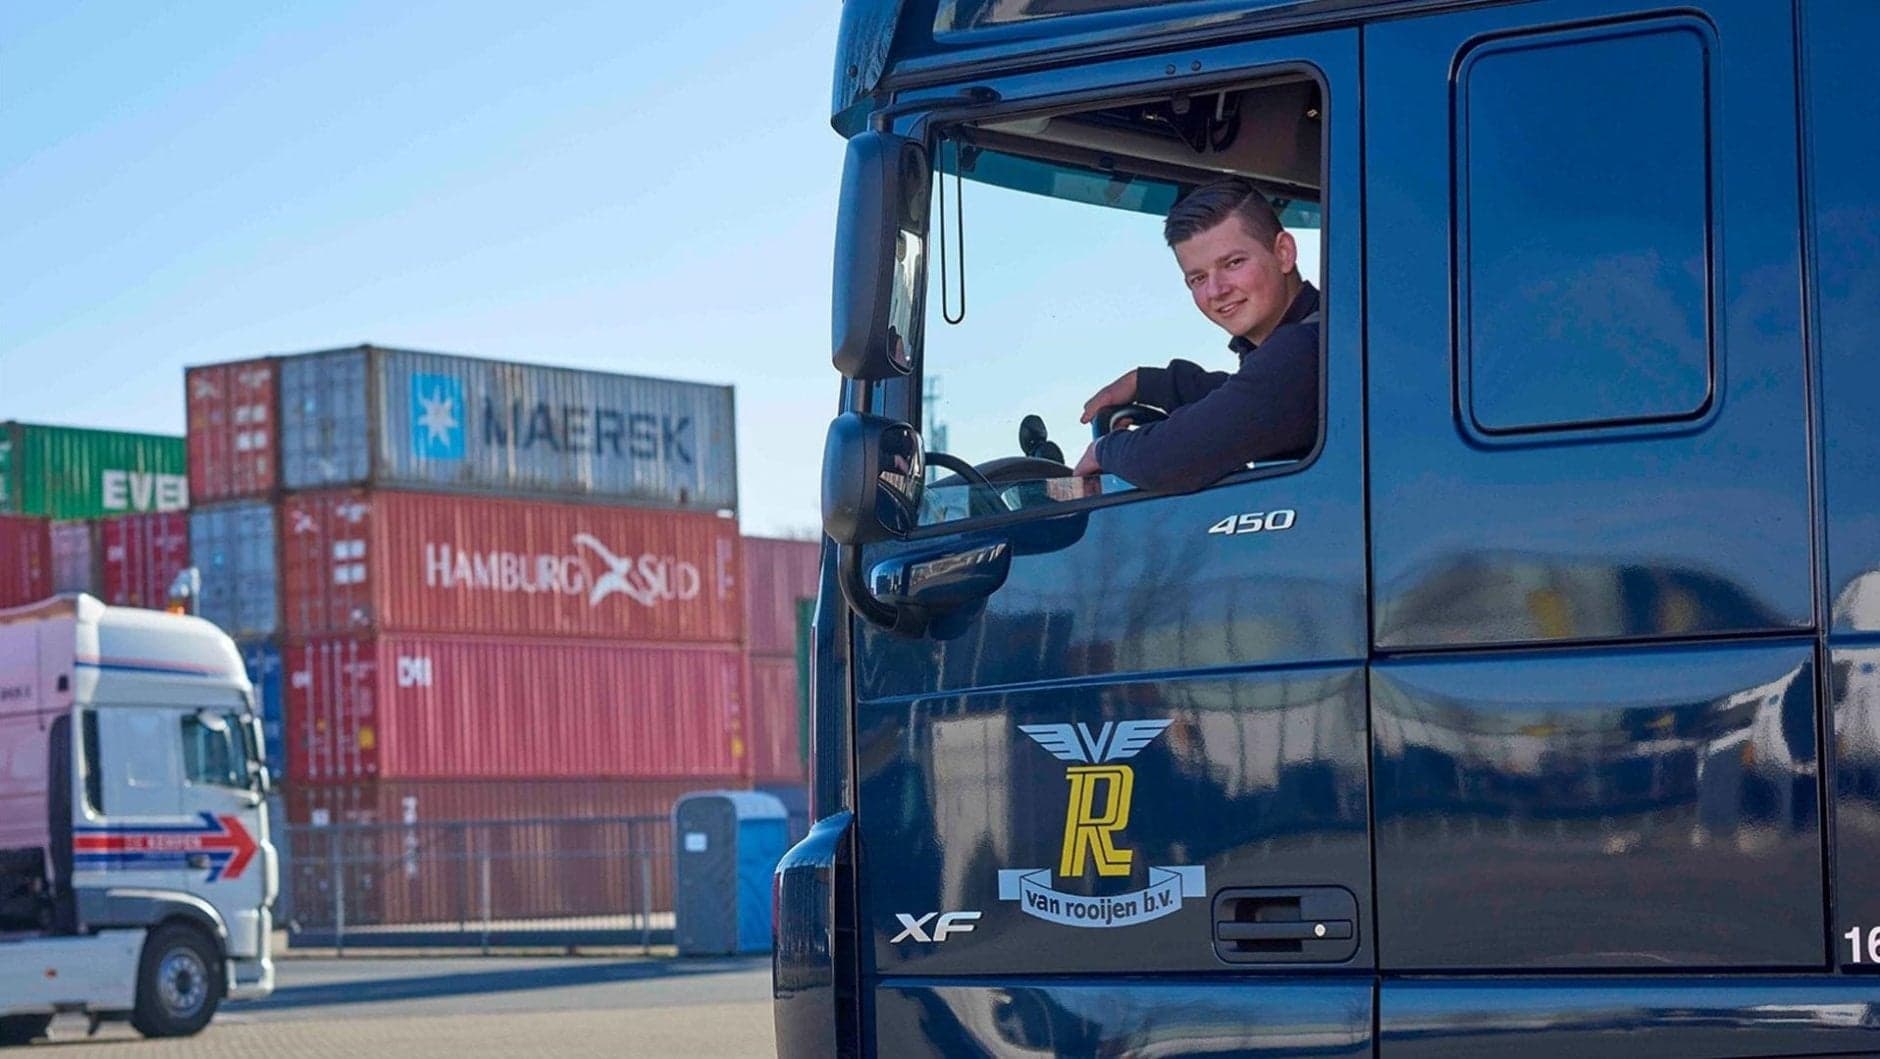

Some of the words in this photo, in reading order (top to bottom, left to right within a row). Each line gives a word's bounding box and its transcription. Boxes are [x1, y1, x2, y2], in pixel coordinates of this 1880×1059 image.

[484, 396, 693, 465] MAERSK
[1208, 509, 1295, 535] 450
[426, 543, 585, 595] HAMBURG
[1059, 764, 1134, 877] R
[890, 911, 982, 943] XF
[1025, 889, 1061, 915] van
[1066, 896, 1137, 925] rooijen
[1143, 889, 1174, 912] b.v.
